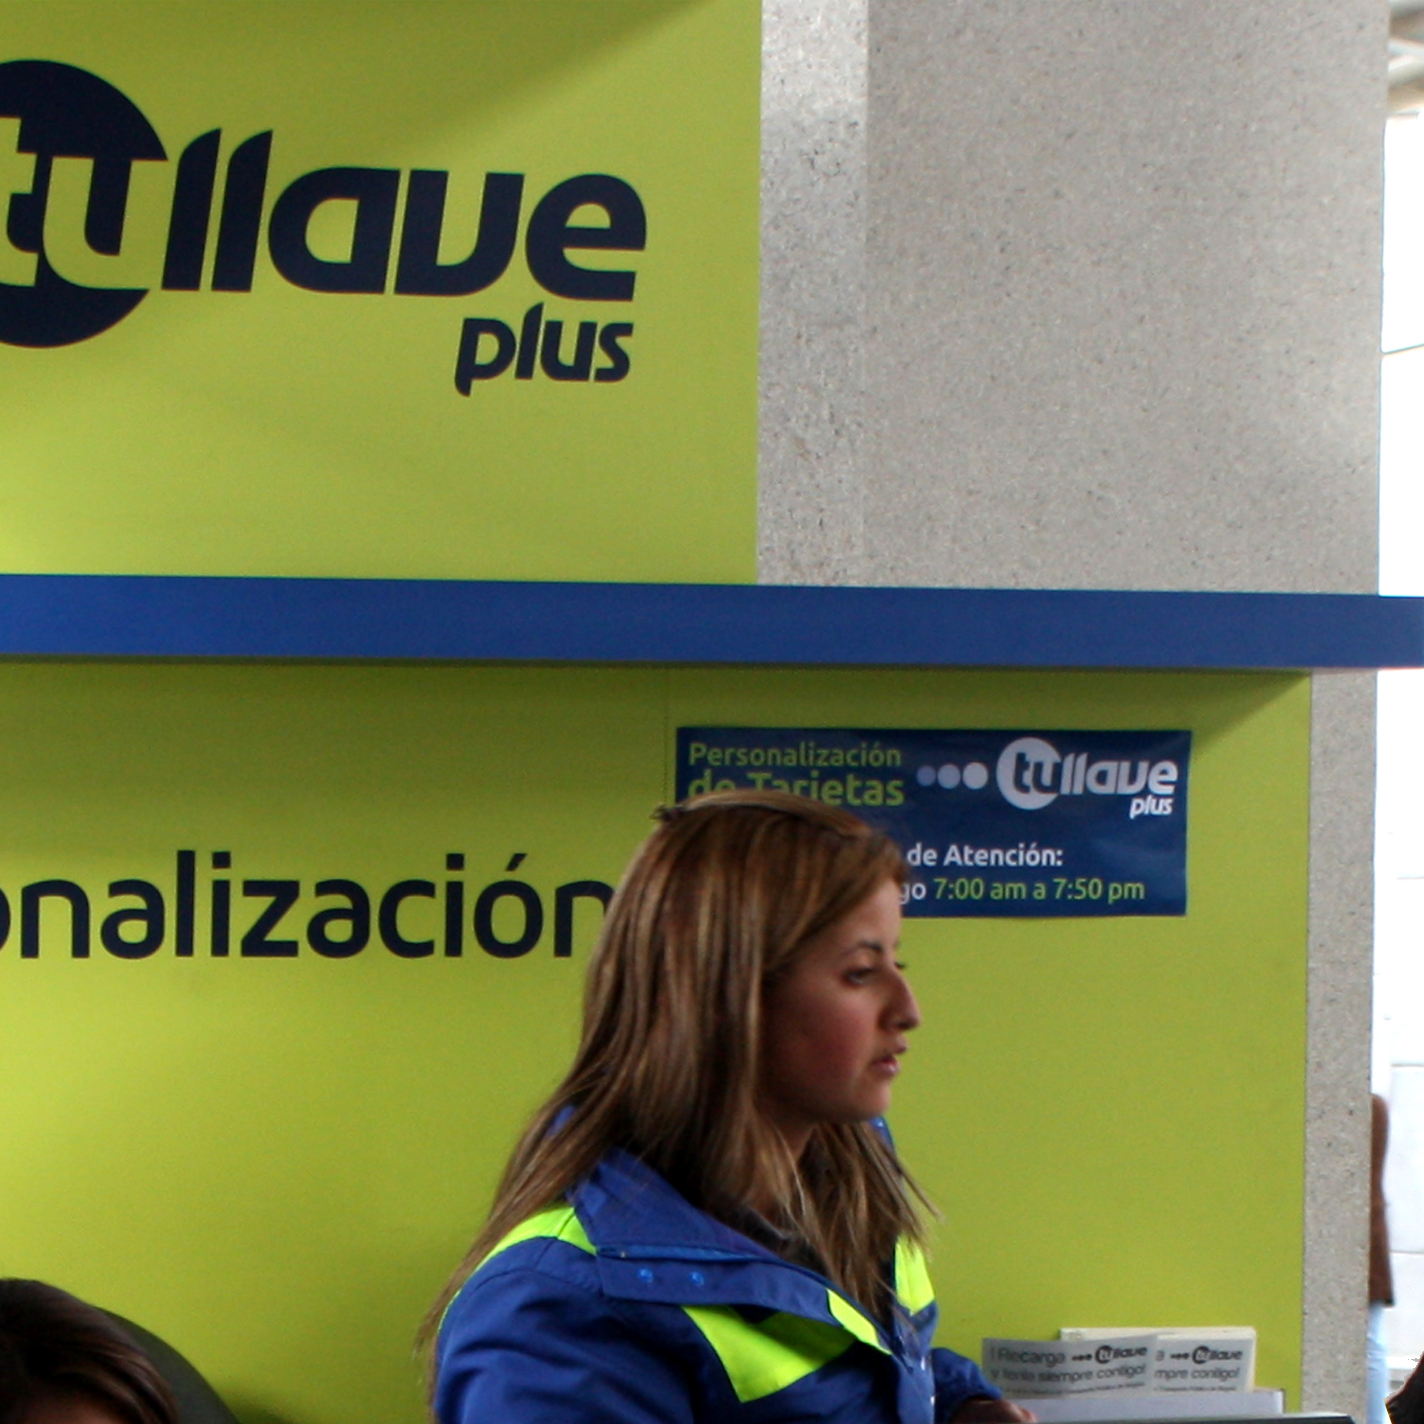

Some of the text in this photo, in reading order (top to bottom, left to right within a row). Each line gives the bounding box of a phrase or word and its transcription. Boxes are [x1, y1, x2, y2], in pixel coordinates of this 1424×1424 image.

[453, 301, 634, 397] plus
[688, 740, 902, 767] Personalización
[1012, 751, 1179, 796] tullave
[1129, 794, 1174, 820] plus
[906, 842, 1064, 867] de Atención:
[933, 877, 984, 900] 7:00
[989, 883, 1026, 900] am
[1032, 883, 1047, 900] a
[1053, 877, 1103, 900] 7:50
[1107, 881, 1146, 905] pm
